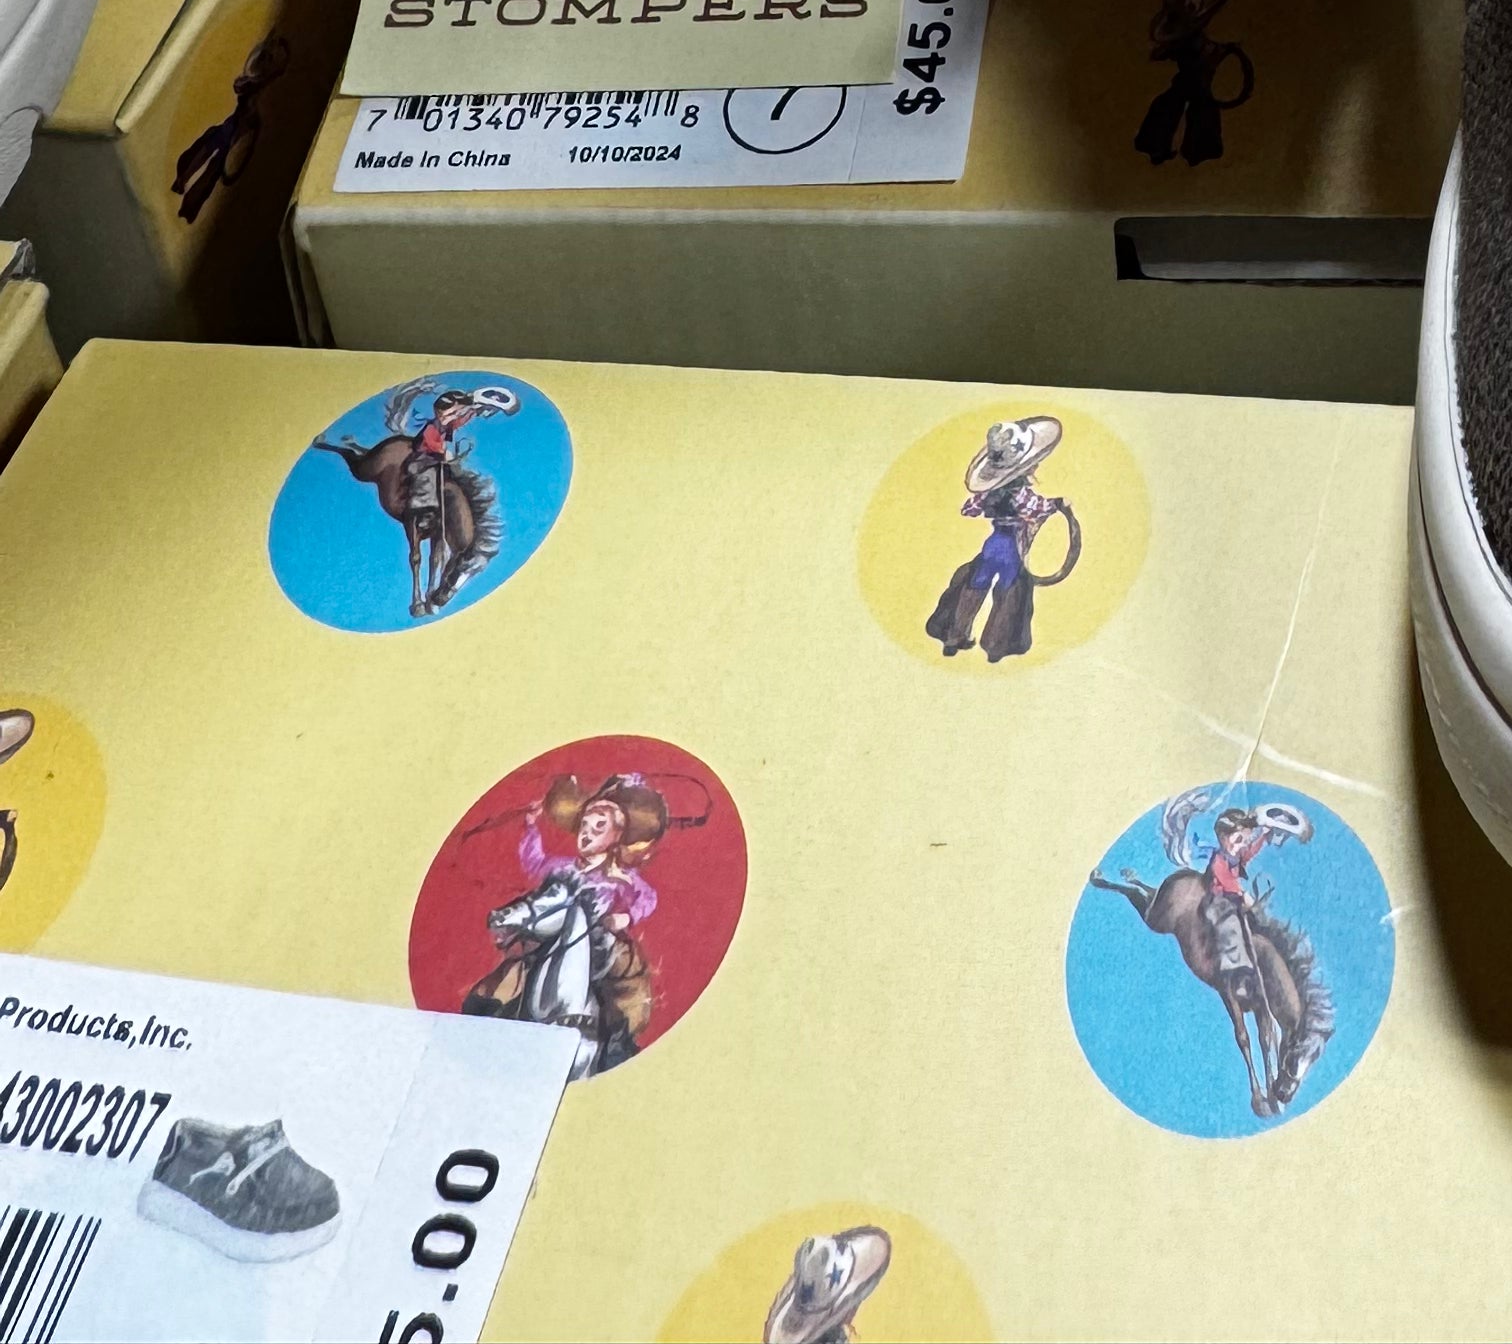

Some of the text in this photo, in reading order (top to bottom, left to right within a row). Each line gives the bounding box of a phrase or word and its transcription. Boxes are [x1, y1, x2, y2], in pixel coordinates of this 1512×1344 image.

[366, 104, 700, 133] 7 01340 79254 8
[354, 151, 413, 169] Made
[447, 149, 511, 168] China
[569, 144, 682, 164] 10/10/2024
